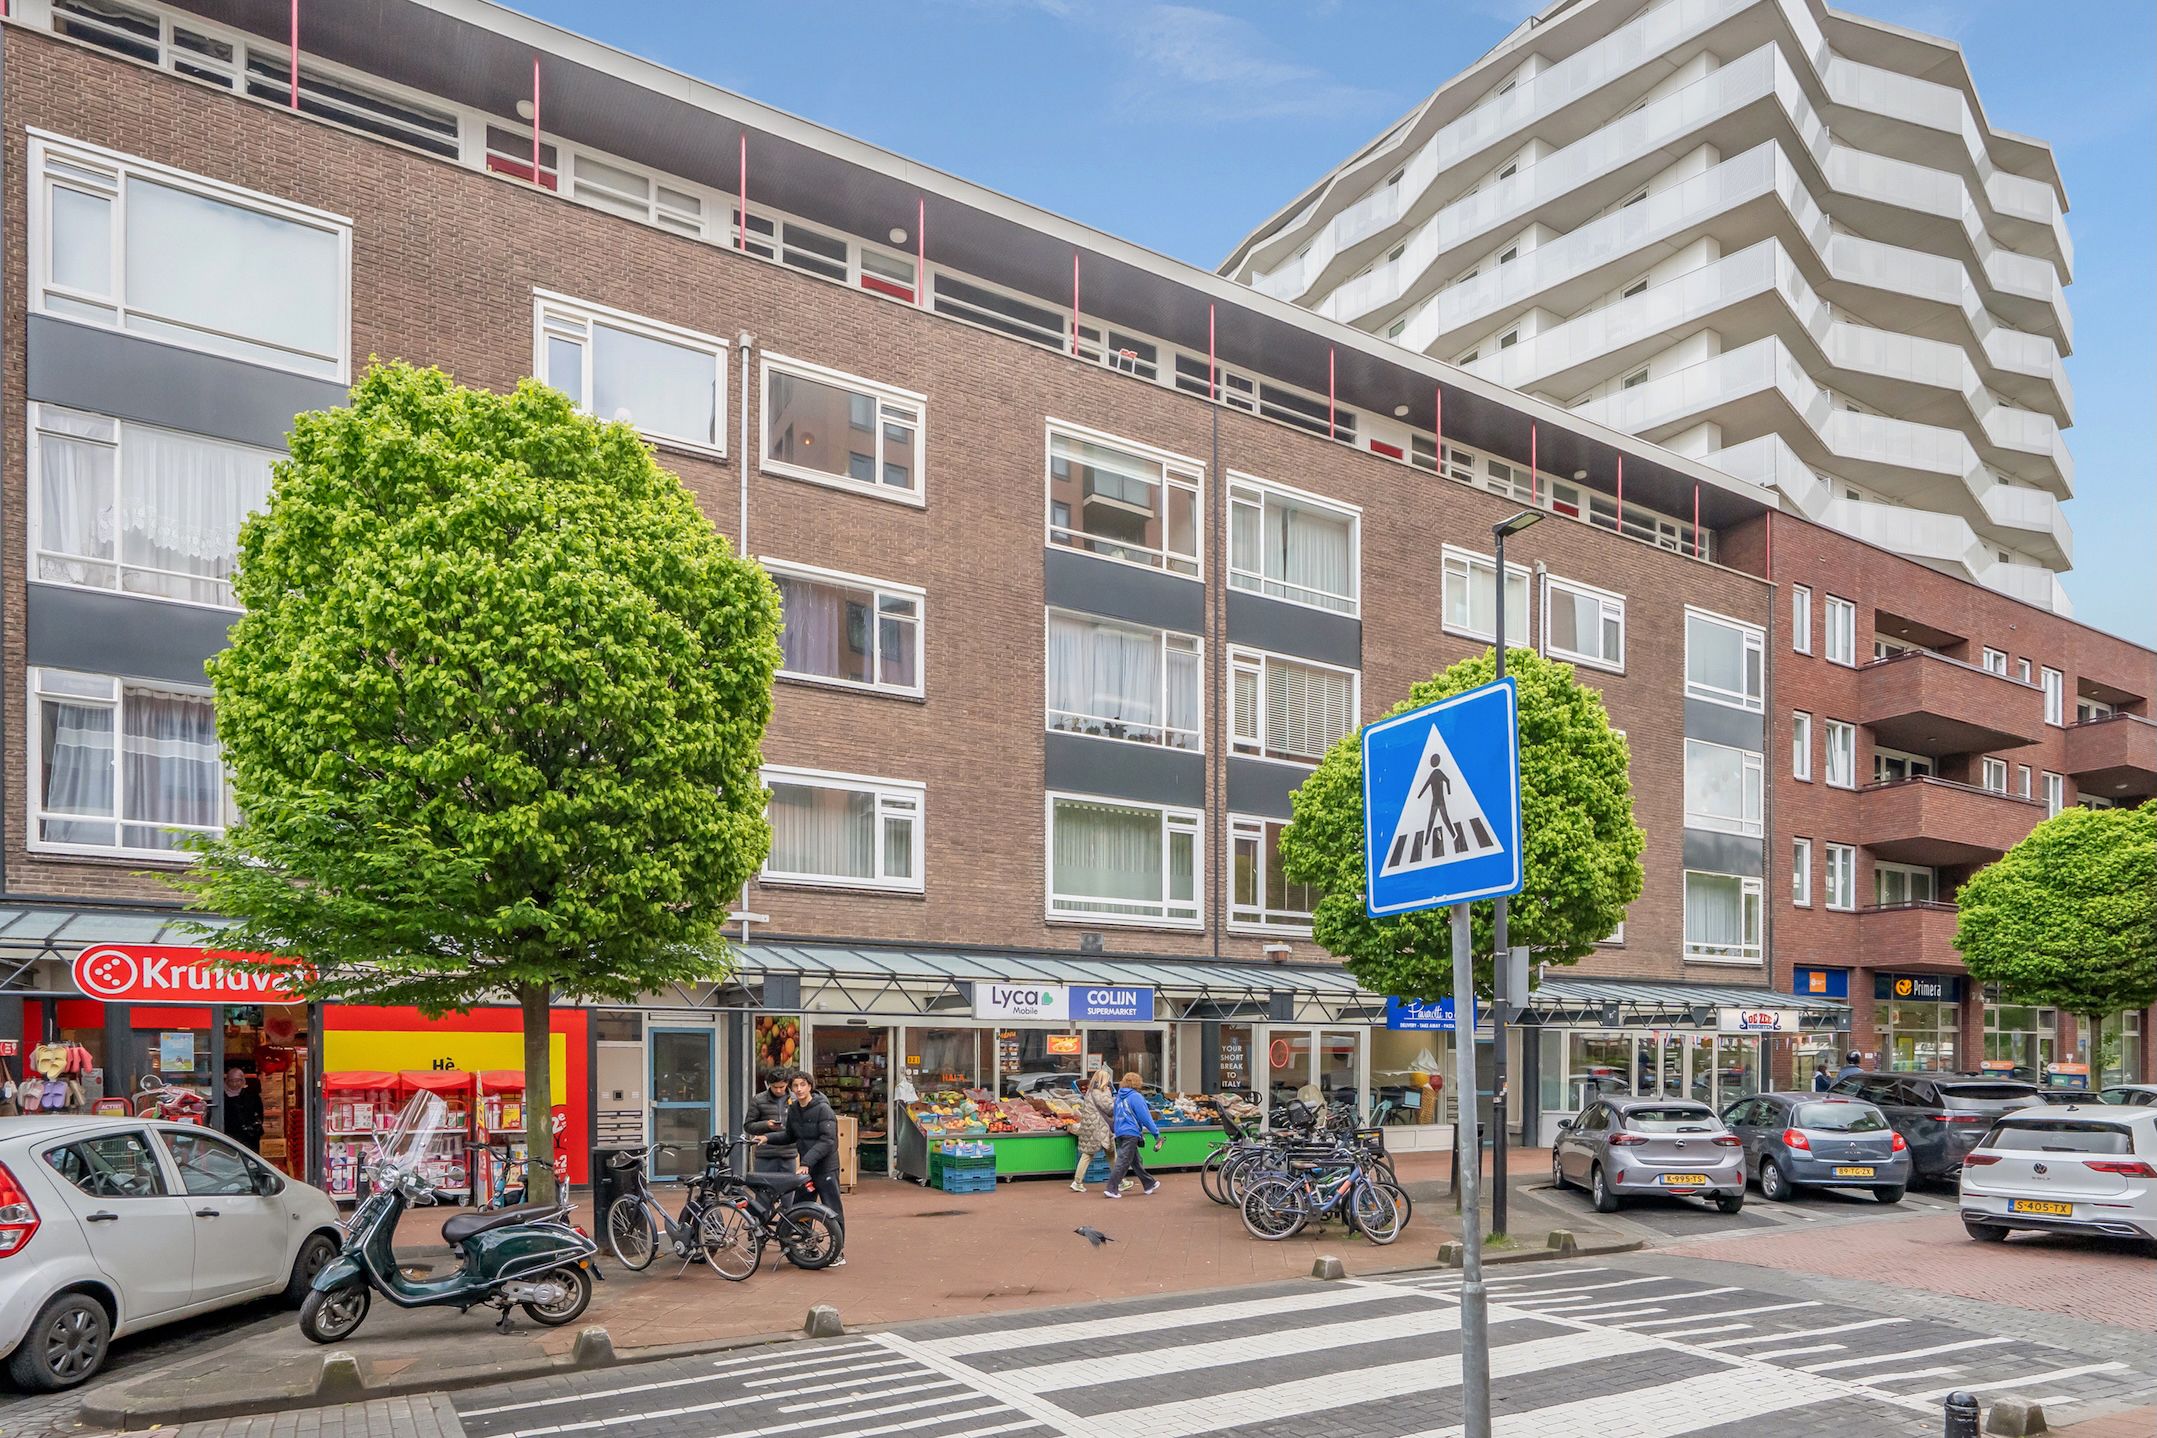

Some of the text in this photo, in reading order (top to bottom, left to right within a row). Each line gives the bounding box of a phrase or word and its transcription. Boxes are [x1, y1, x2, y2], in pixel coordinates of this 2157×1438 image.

[1914, 979, 1942, 997] Primera
[992, 986, 1038, 1009] Lyca
[1086, 990, 1137, 1006] COLIJN
[1012, 1006, 1039, 1015] Mobile
[1087, 1007, 1137, 1016] SUPERMARKET
[1759, 1013, 1773, 1025] ZEE
[1227, 1071, 1237, 1079] TO
[1222, 1080, 1241, 1088] ITALY
[1666, 1175, 1703, 1183] K-995-TS
[2017, 1201, 2068, 1214] S-405-TX
